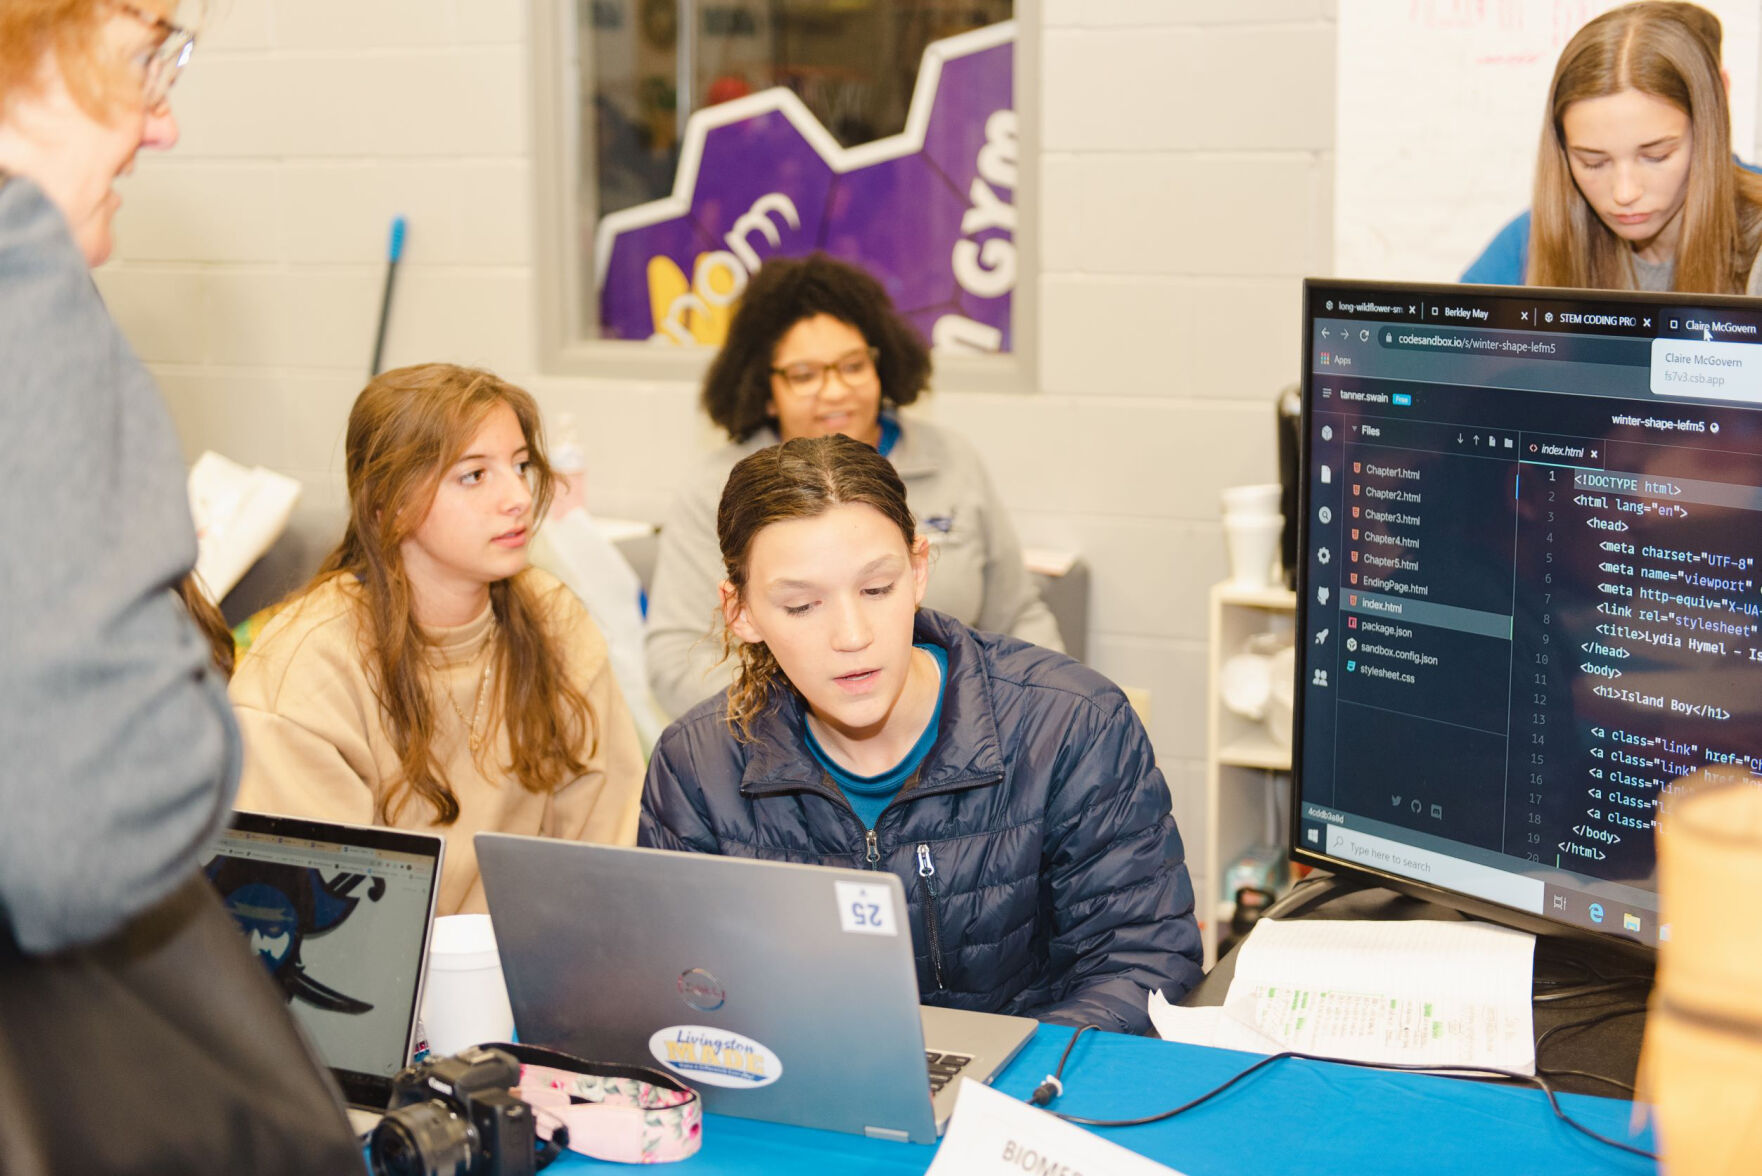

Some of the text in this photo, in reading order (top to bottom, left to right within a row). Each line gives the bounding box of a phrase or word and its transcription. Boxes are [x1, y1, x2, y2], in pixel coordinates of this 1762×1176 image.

[1445, 307, 1488, 321] Berkley May
[1560, 313, 1636, 327] STEM CODING PRO
[1686, 320, 1757, 335] Claire McGovern
[1398, 333, 1556, 355] codesandbox.io/s/winter-shape-lefm5
[1334, 354, 1351, 365] Apps
[1665, 352, 1742, 368] Claire McGovern
[1340, 389, 1409, 403] tanner.swain Free
[1362, 425, 1380, 437] Files
[1611, 413, 1705, 433] winter-shape-lefm5
[1541, 444, 1584, 458] index.html
[1367, 464, 1420, 480] Chapter1.html
[1549, 471, 1682, 496] 1 <!DOCTYPE html>
[1366, 487, 1421, 503] Chapter2.html
[1548, 492, 1688, 518] 2 <html lang="en">
[1365, 509, 1421, 526] Chapter3.html
[1586, 518, 1629, 532] <head>
[1364, 531, 1420, 548] Chapter4.html
[1364, 553, 1419, 571] Chapter5.html
[1599, 541, 1635, 554] <meta
[1642, 546, 1754, 570] charset="UTF-8"
[1363, 576, 1428, 595] EndingPage.html
[1598, 562, 1634, 575] <meta
[1641, 567, 1752, 592] name="viewport"
[1597, 583, 1633, 596] <meta
[1362, 598, 1402, 614] index.html
[1596, 603, 1632, 617] <link
[1639, 610, 1758, 637] rel="stylesheet"
[1362, 620, 1412, 639] package.json
[1596, 624, 1681, 648] <title>Lydia
[1689, 638, 1726, 655] Hymel
[1361, 642, 1439, 665] sandbox.config.json
[1581, 642, 1630, 659] </head>
[1360, 663, 1415, 684] stylesheet.css
[1580, 662, 1622, 679] <body>
[1593, 685, 1663, 708] <h1>Island
[1671, 699, 1731, 720] Boy</h1>
[1591, 728, 1605, 738] <a
[1612, 731, 1698, 755] class="link"
[1590, 748, 1603, 758] <a
[1611, 751, 1696, 776] class="link"
[1589, 768, 1603, 779] <a
[1588, 788, 1602, 799] <a
[1587, 809, 1601, 819] <a
[1572, 823, 1621, 844] </body>
[1350, 842, 1431, 872] Type here to search
[1558, 839, 1606, 860] </html>
[852, 902, 882, 926] 25
[677, 1030, 754, 1055] Livingston
[664, 1040, 764, 1075] MADE
